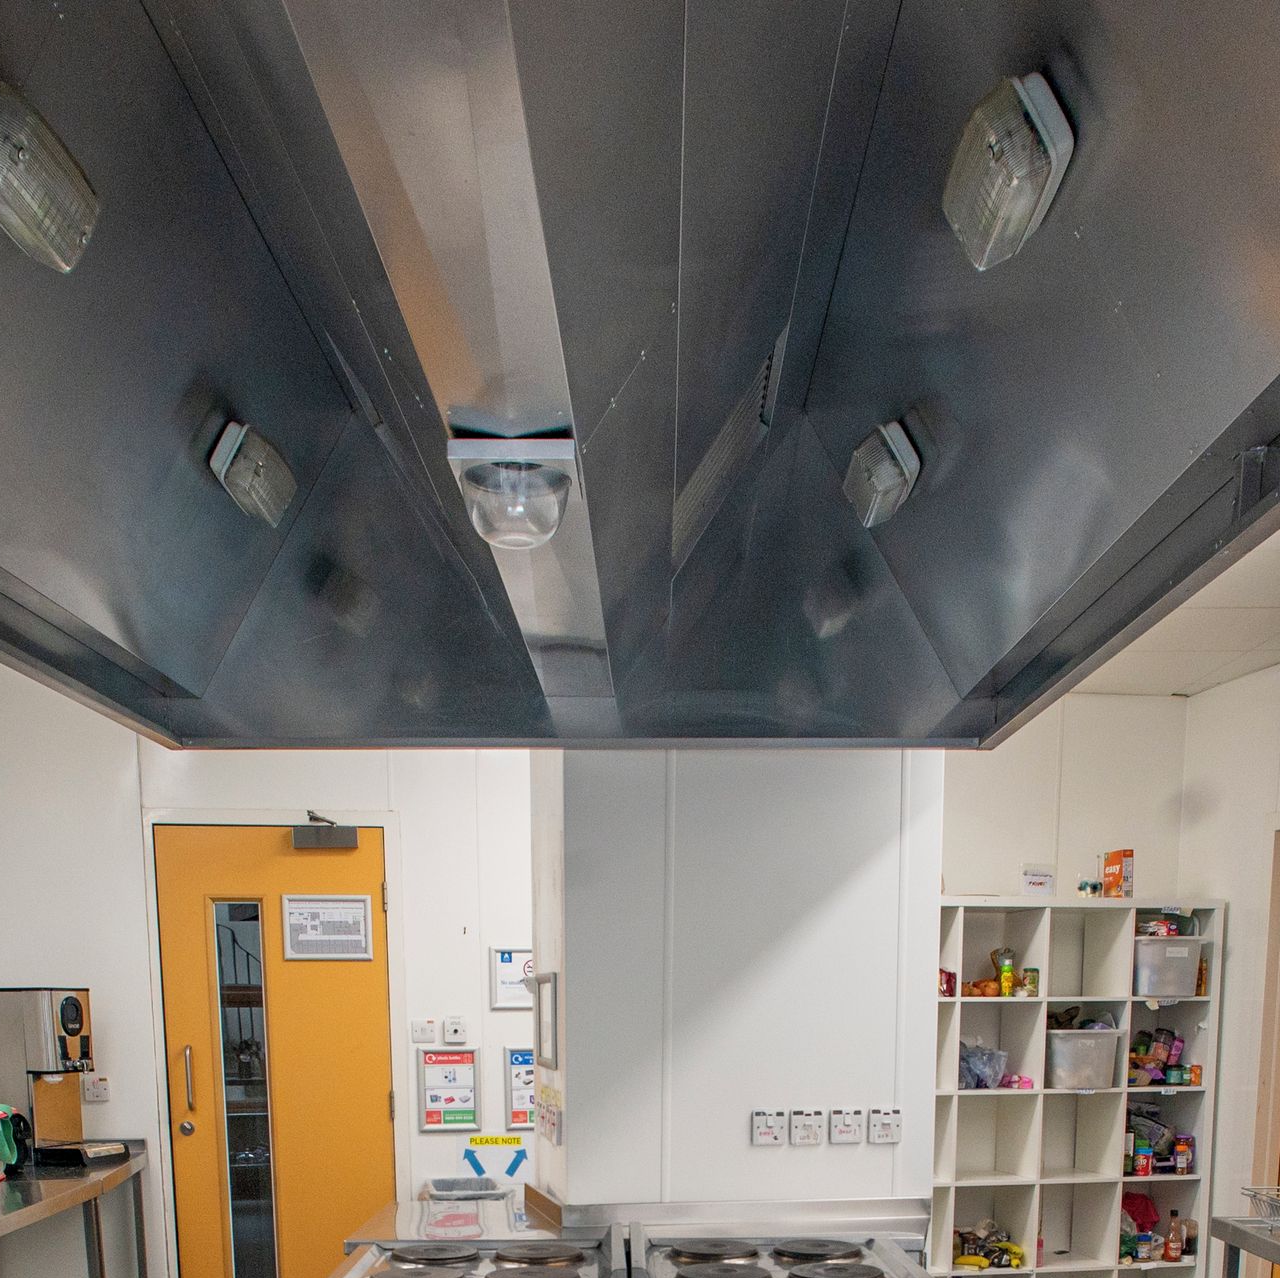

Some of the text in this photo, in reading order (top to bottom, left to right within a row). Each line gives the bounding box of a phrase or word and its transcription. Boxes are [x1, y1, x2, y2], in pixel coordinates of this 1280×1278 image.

[1105, 864, 1121, 874] easy
[470, 1137, 521, 1145] PLEASE NOTE
